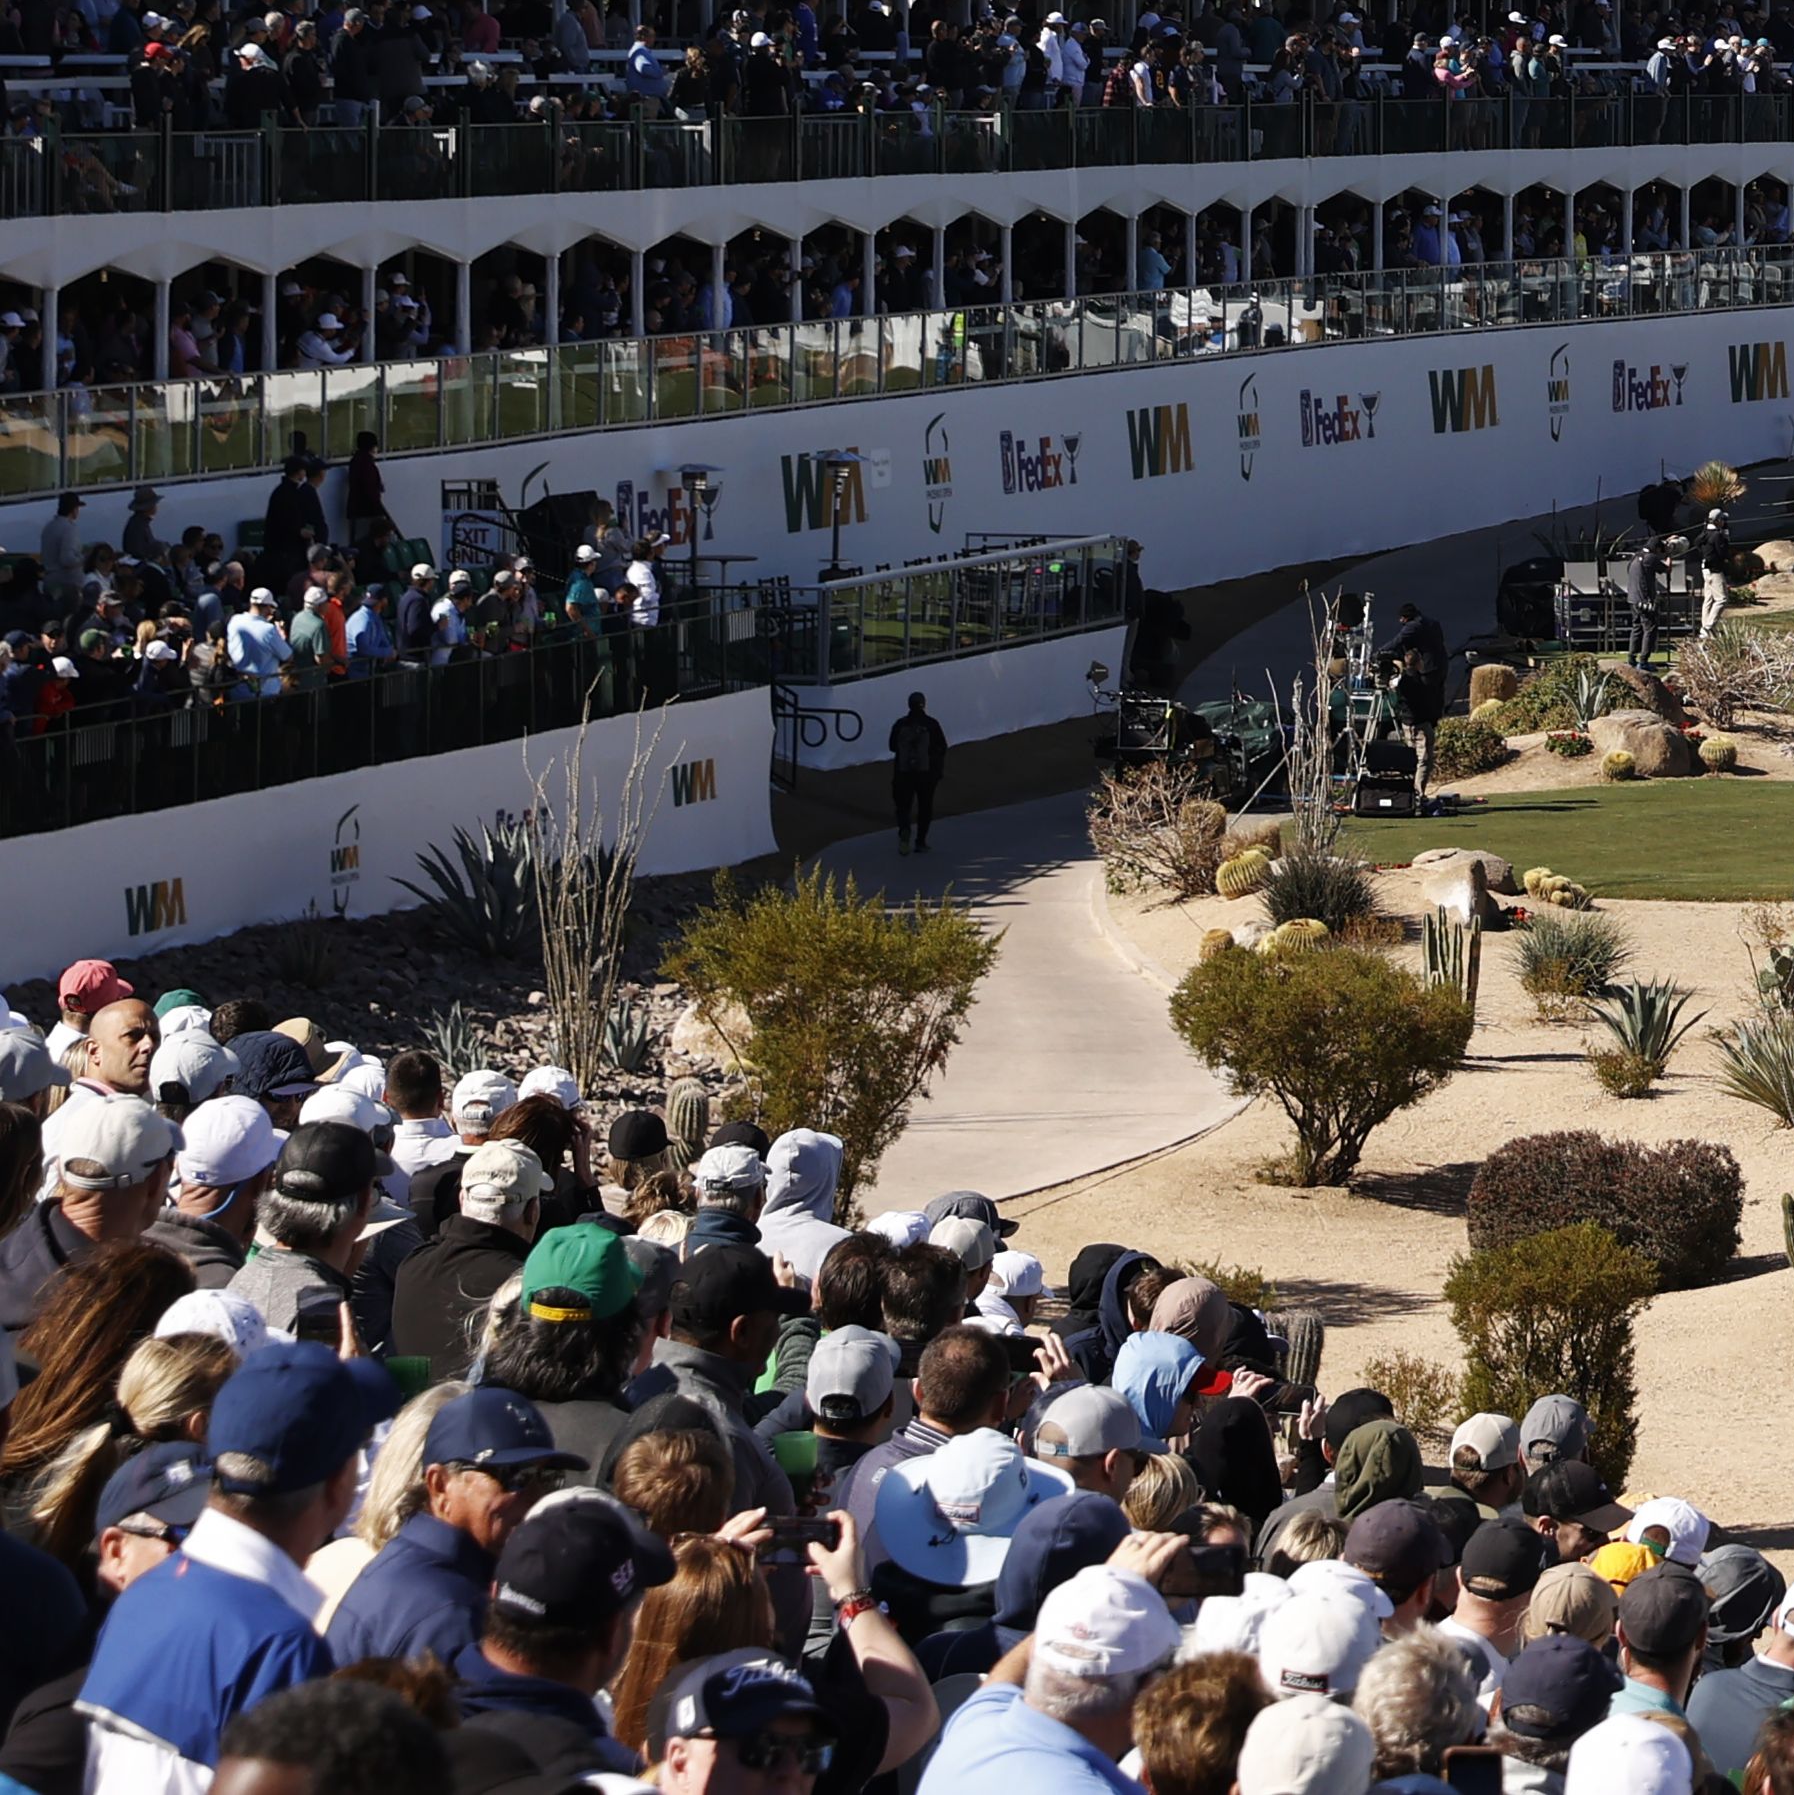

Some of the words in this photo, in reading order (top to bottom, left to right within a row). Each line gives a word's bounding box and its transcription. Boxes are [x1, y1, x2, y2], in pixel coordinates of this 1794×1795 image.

[1547, 380, 1570, 402] WM
[1628, 365, 1671, 412] FedEx
[1728, 341, 1790, 403] WM
[1314, 394, 1361, 446] FedEx
[1428, 364, 1499, 434] WM
[1126, 403, 1194, 480] WM
[1238, 413, 1260, 438] WM
[923, 458, 951, 485] WM
[1016, 436, 1063, 493] FedEx
[781, 446, 868, 534] WM
[672, 758, 718, 807] WM
[331, 845, 360, 873] WM
[125, 877, 187, 926] WM
